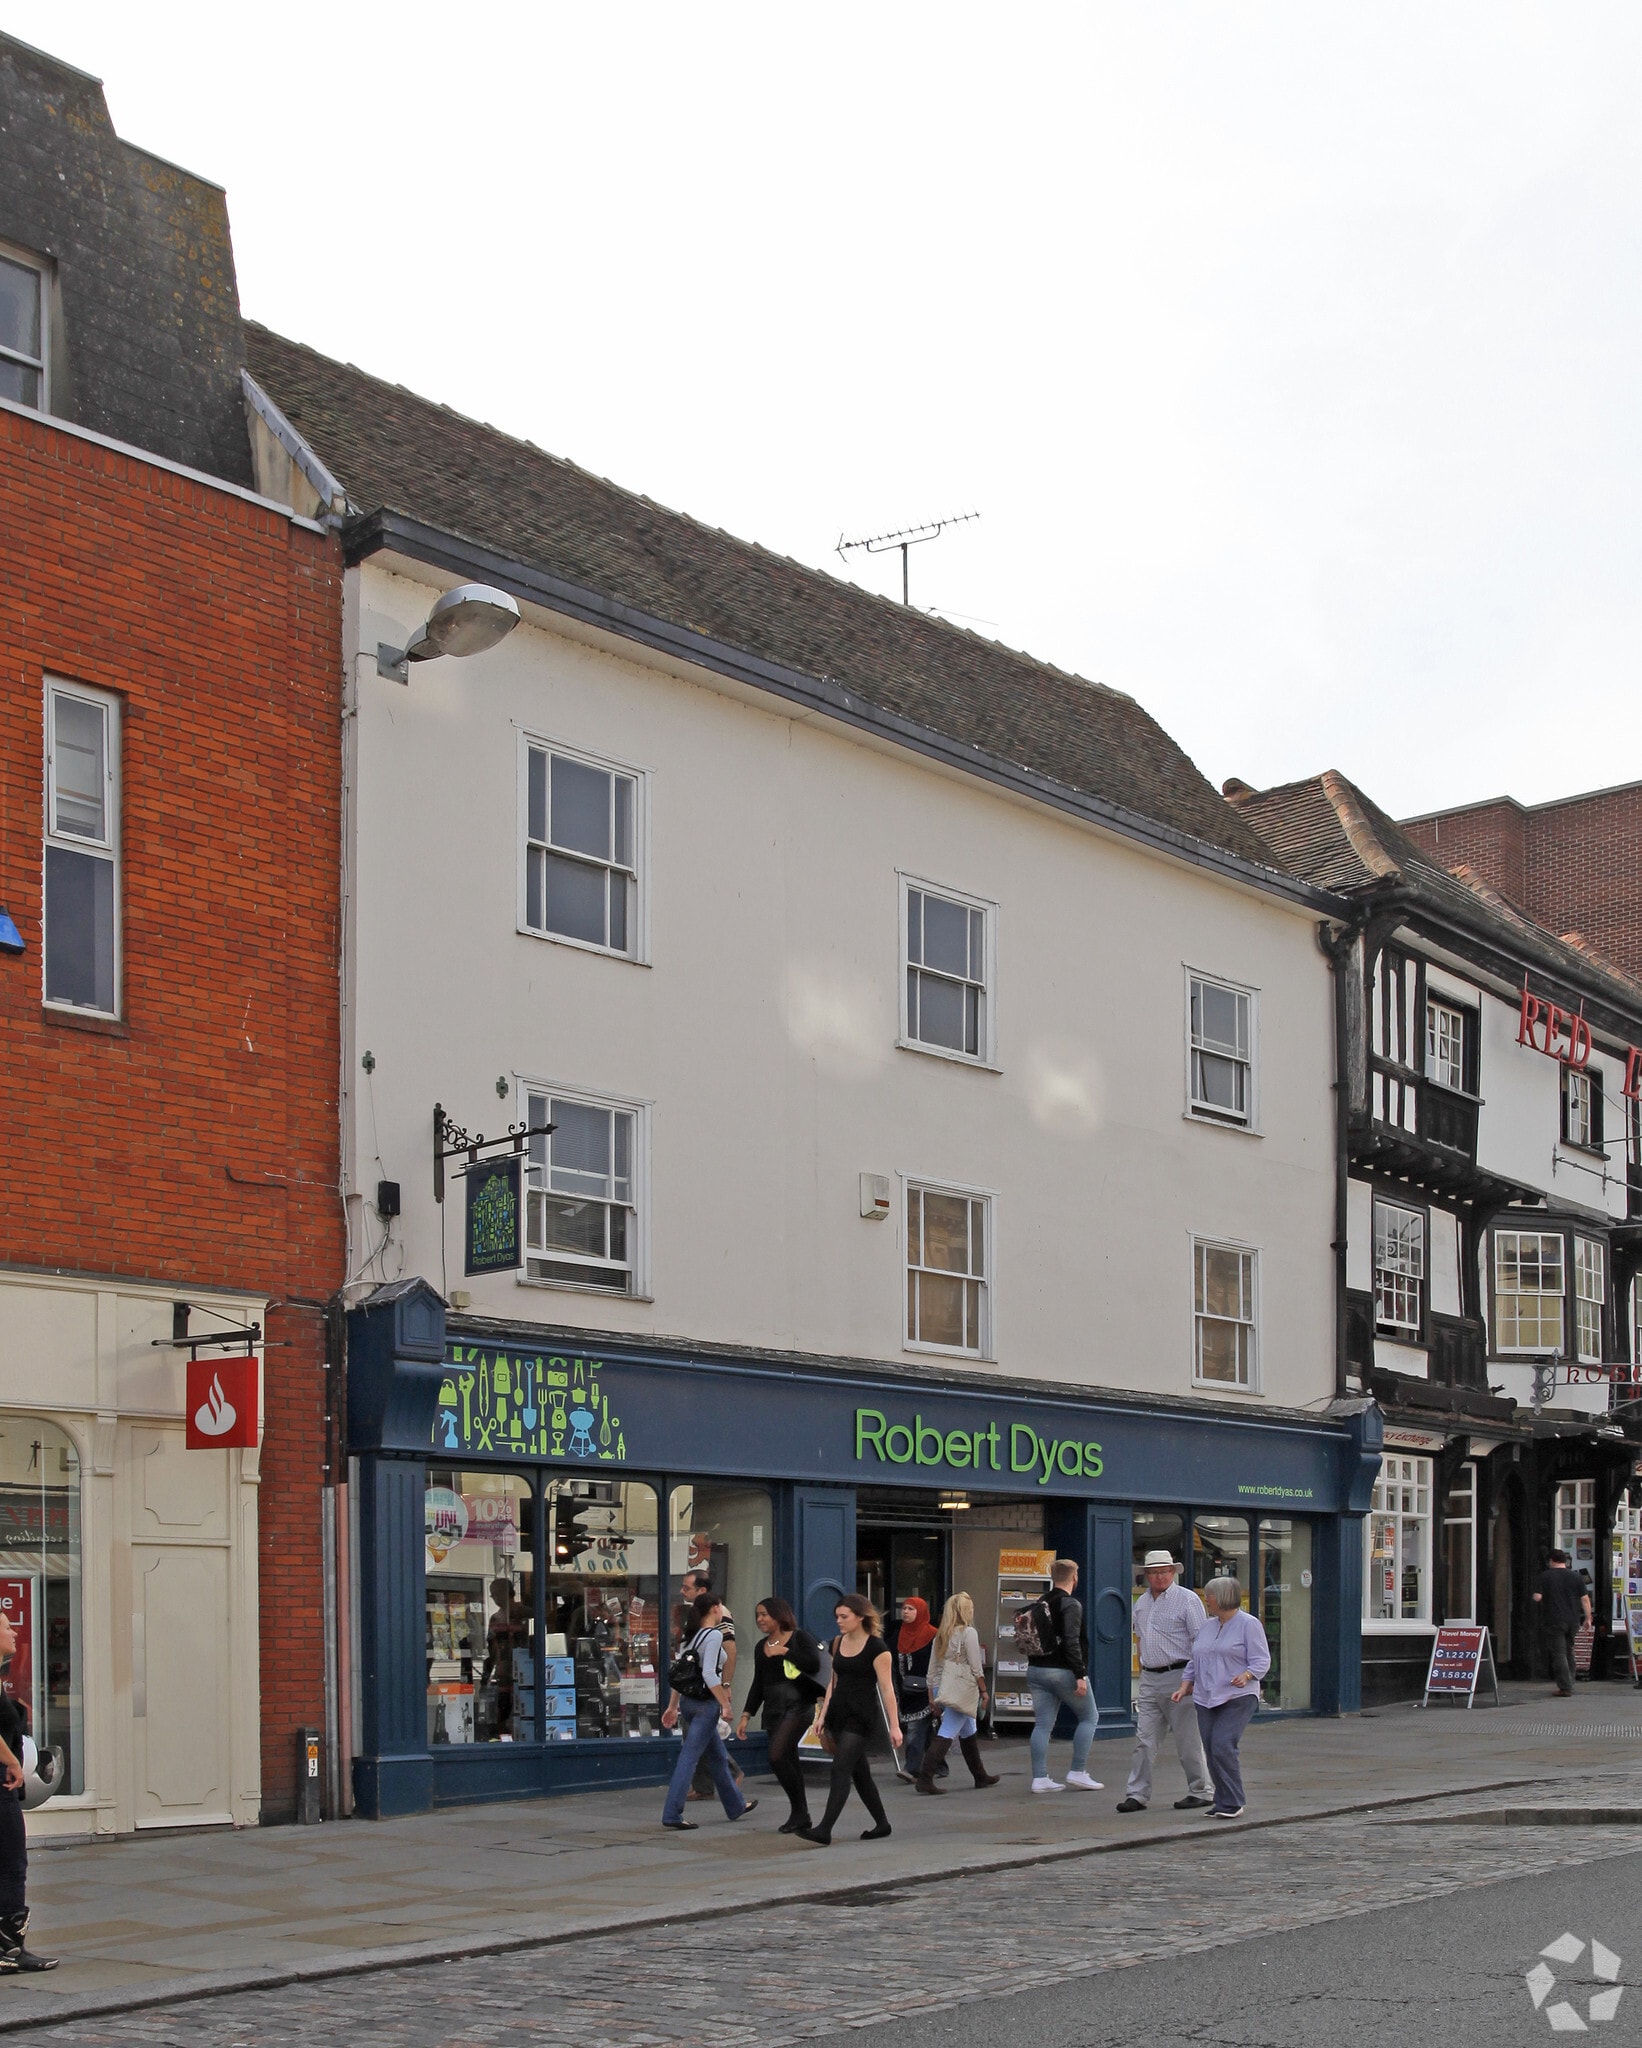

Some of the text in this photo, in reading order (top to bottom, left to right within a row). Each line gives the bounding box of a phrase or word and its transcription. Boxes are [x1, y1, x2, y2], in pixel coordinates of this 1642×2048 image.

[1515, 990, 1592, 1070] RED
[473, 1252, 514, 1265] Robert Dyas
[856, 1408, 1104, 1485] Robert Dyas
[1238, 1485, 1313, 1498] www.robertdyas.co.uk
[436, 1509, 457, 1528] UNI
[471, 1498, 512, 1522] 10%
[1001, 1556, 1037, 1566] SEASON
